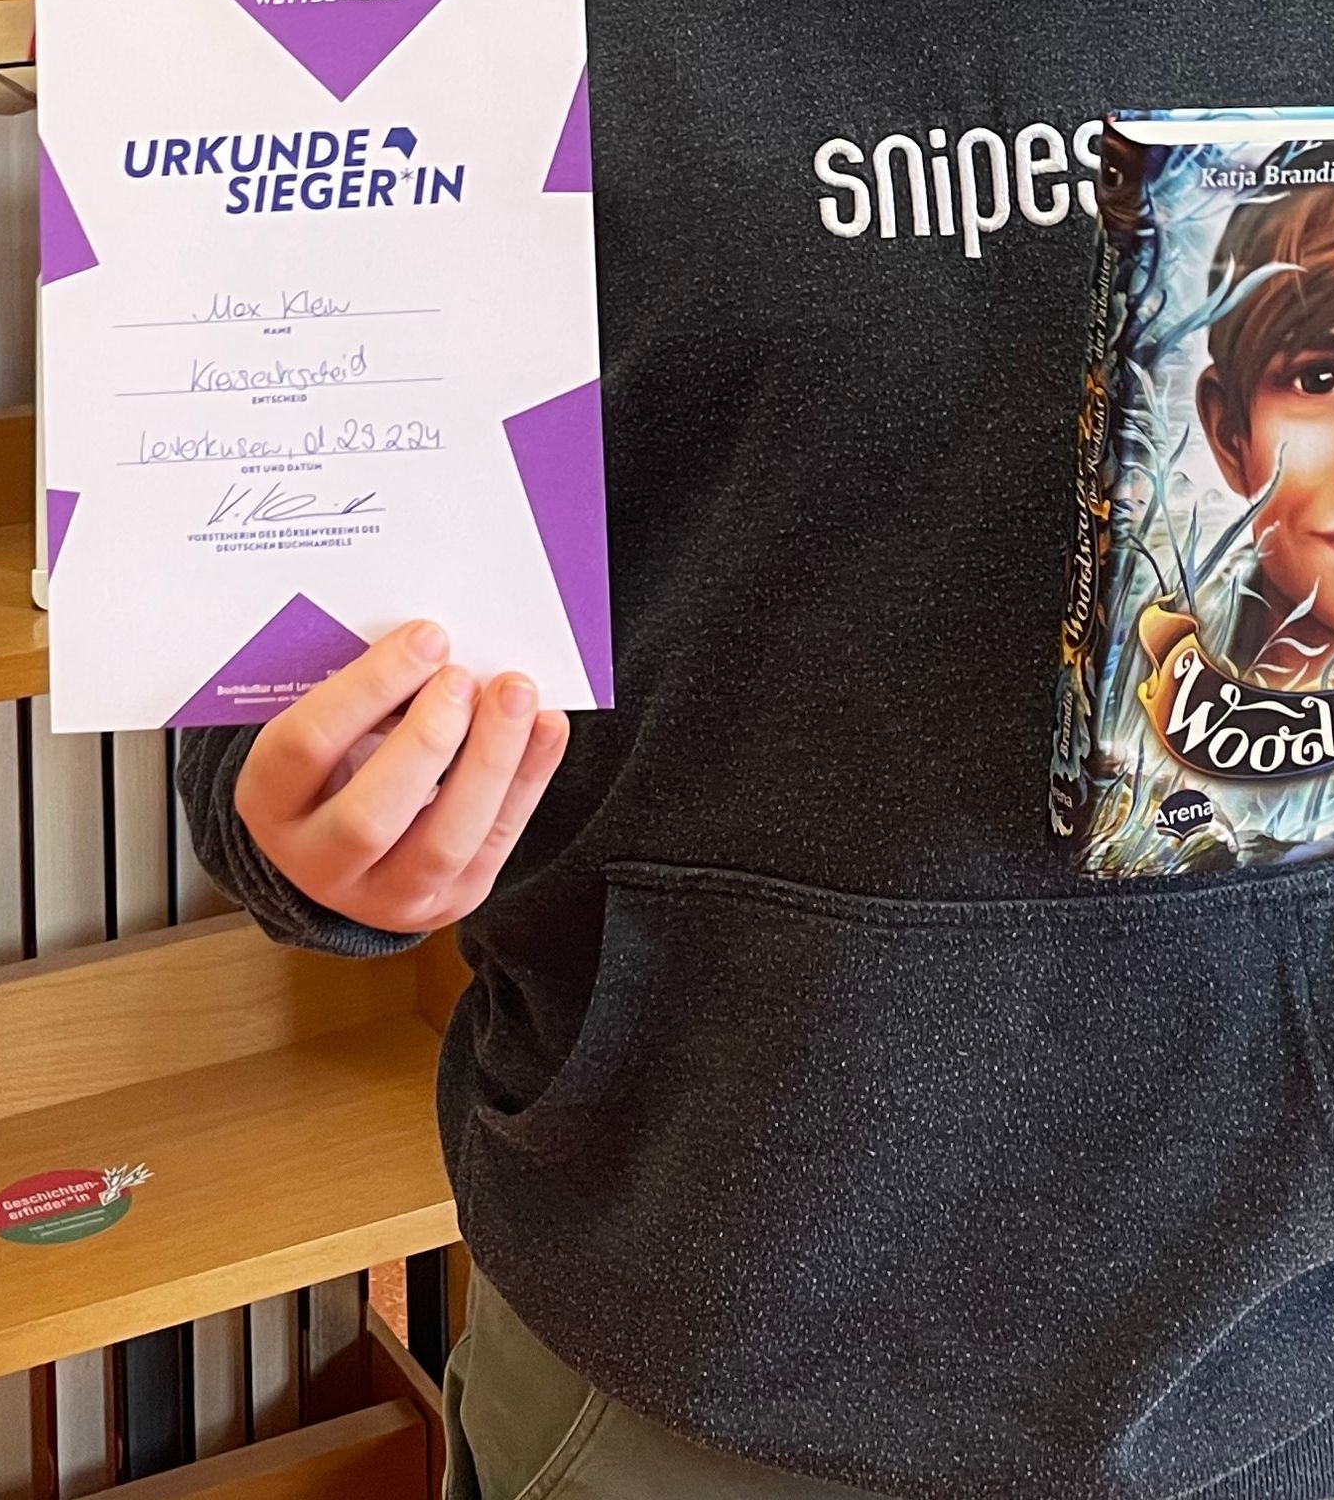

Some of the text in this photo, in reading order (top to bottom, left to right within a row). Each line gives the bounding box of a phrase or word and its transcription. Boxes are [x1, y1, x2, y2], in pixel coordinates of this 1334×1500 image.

[123, 128, 372, 178] URKUNDE
[1200, 165, 1257, 190] Katja
[252, 394, 307, 404] ENTSCHEID
[1153, 799, 1214, 828] Arena
